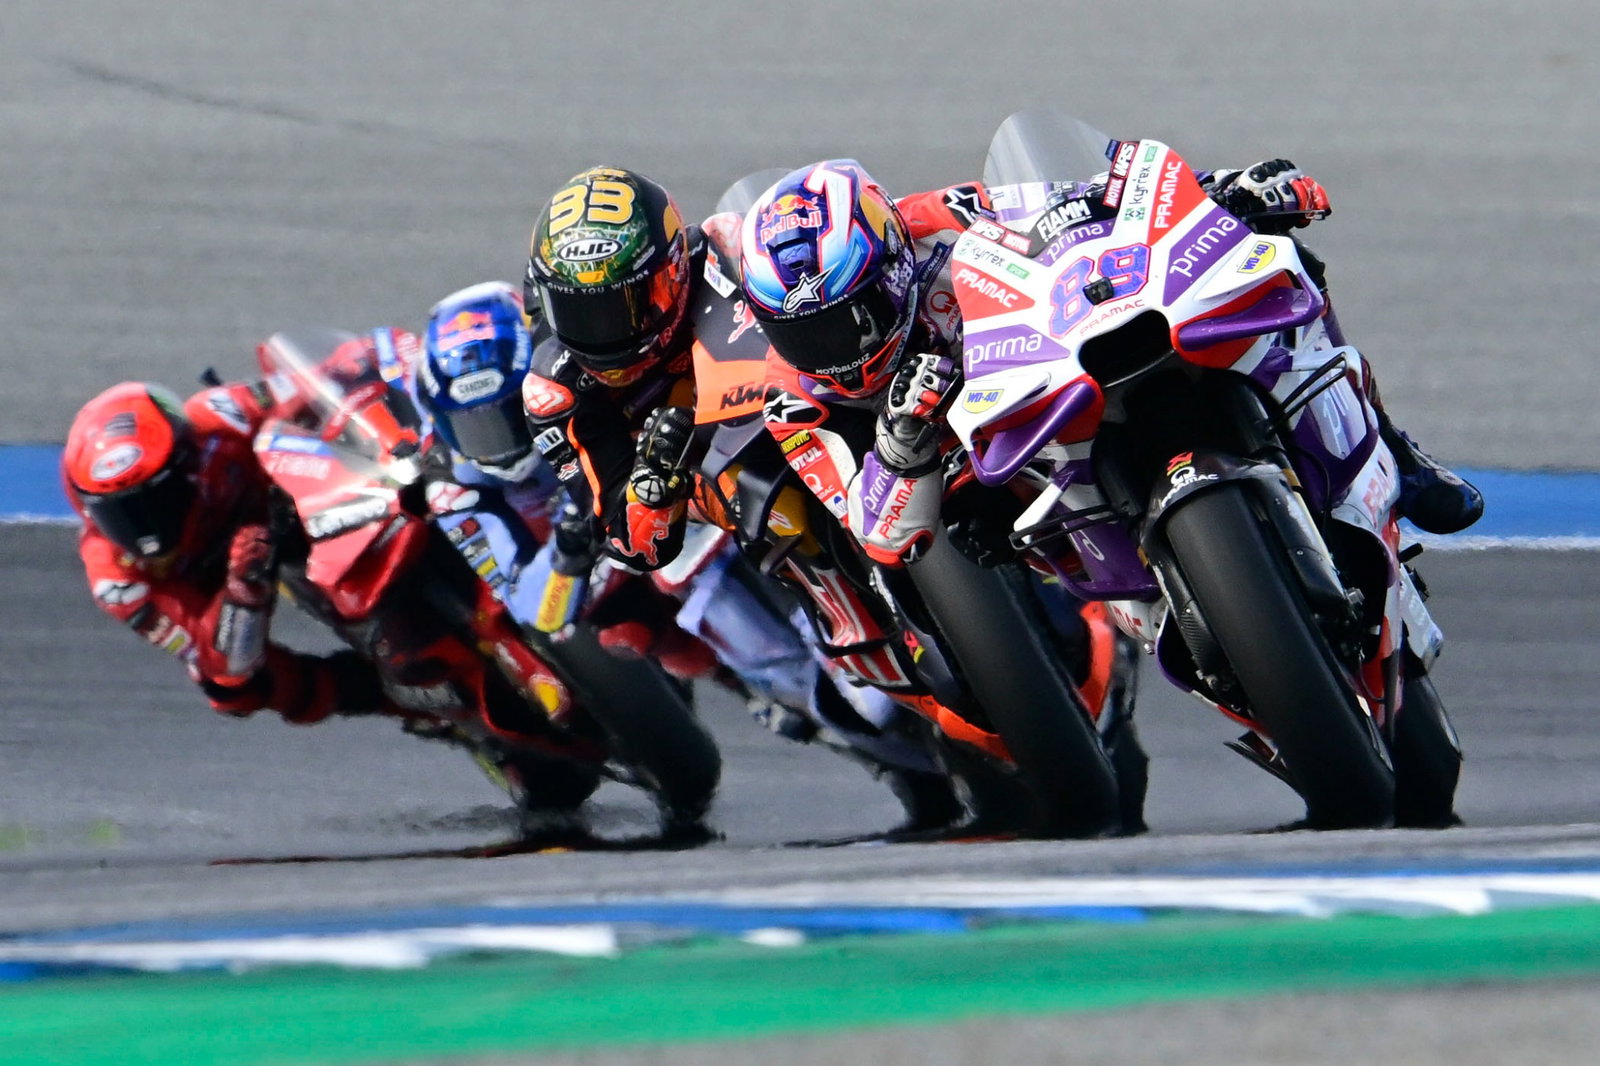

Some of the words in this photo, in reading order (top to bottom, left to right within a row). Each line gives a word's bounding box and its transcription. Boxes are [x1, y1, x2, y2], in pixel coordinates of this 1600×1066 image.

[549, 180, 636, 237] 33
[1104, 178, 1123, 208] MOTUL
[1154, 161, 1183, 229] PRAMAC
[787, 210, 822, 231] Bull
[1036, 199, 1091, 240] FIAMM
[565, 242, 612, 259] HJC
[1046, 223, 1104, 261] prima
[1169, 216, 1238, 277] prima
[1241, 244, 1269, 270] WD-40
[547, 282, 575, 295] GIVES
[581, 286, 605, 296] YOU
[611, 270, 650, 291] WINGS
[955, 268, 1019, 308] PRAMAC
[1049, 243, 1151, 339] 89
[799, 308, 817, 318] YOU
[821, 294, 849, 310] WINGS
[1080, 299, 1145, 336] PRAMAC
[816, 353, 871, 375] MOTOBLOUZ
[964, 333, 1042, 373] prima
[719, 384, 765, 410] KTM
[967, 390, 998, 403] WD-40
[789, 447, 822, 472] OTUL
[878, 478, 918, 539] PRAMA
